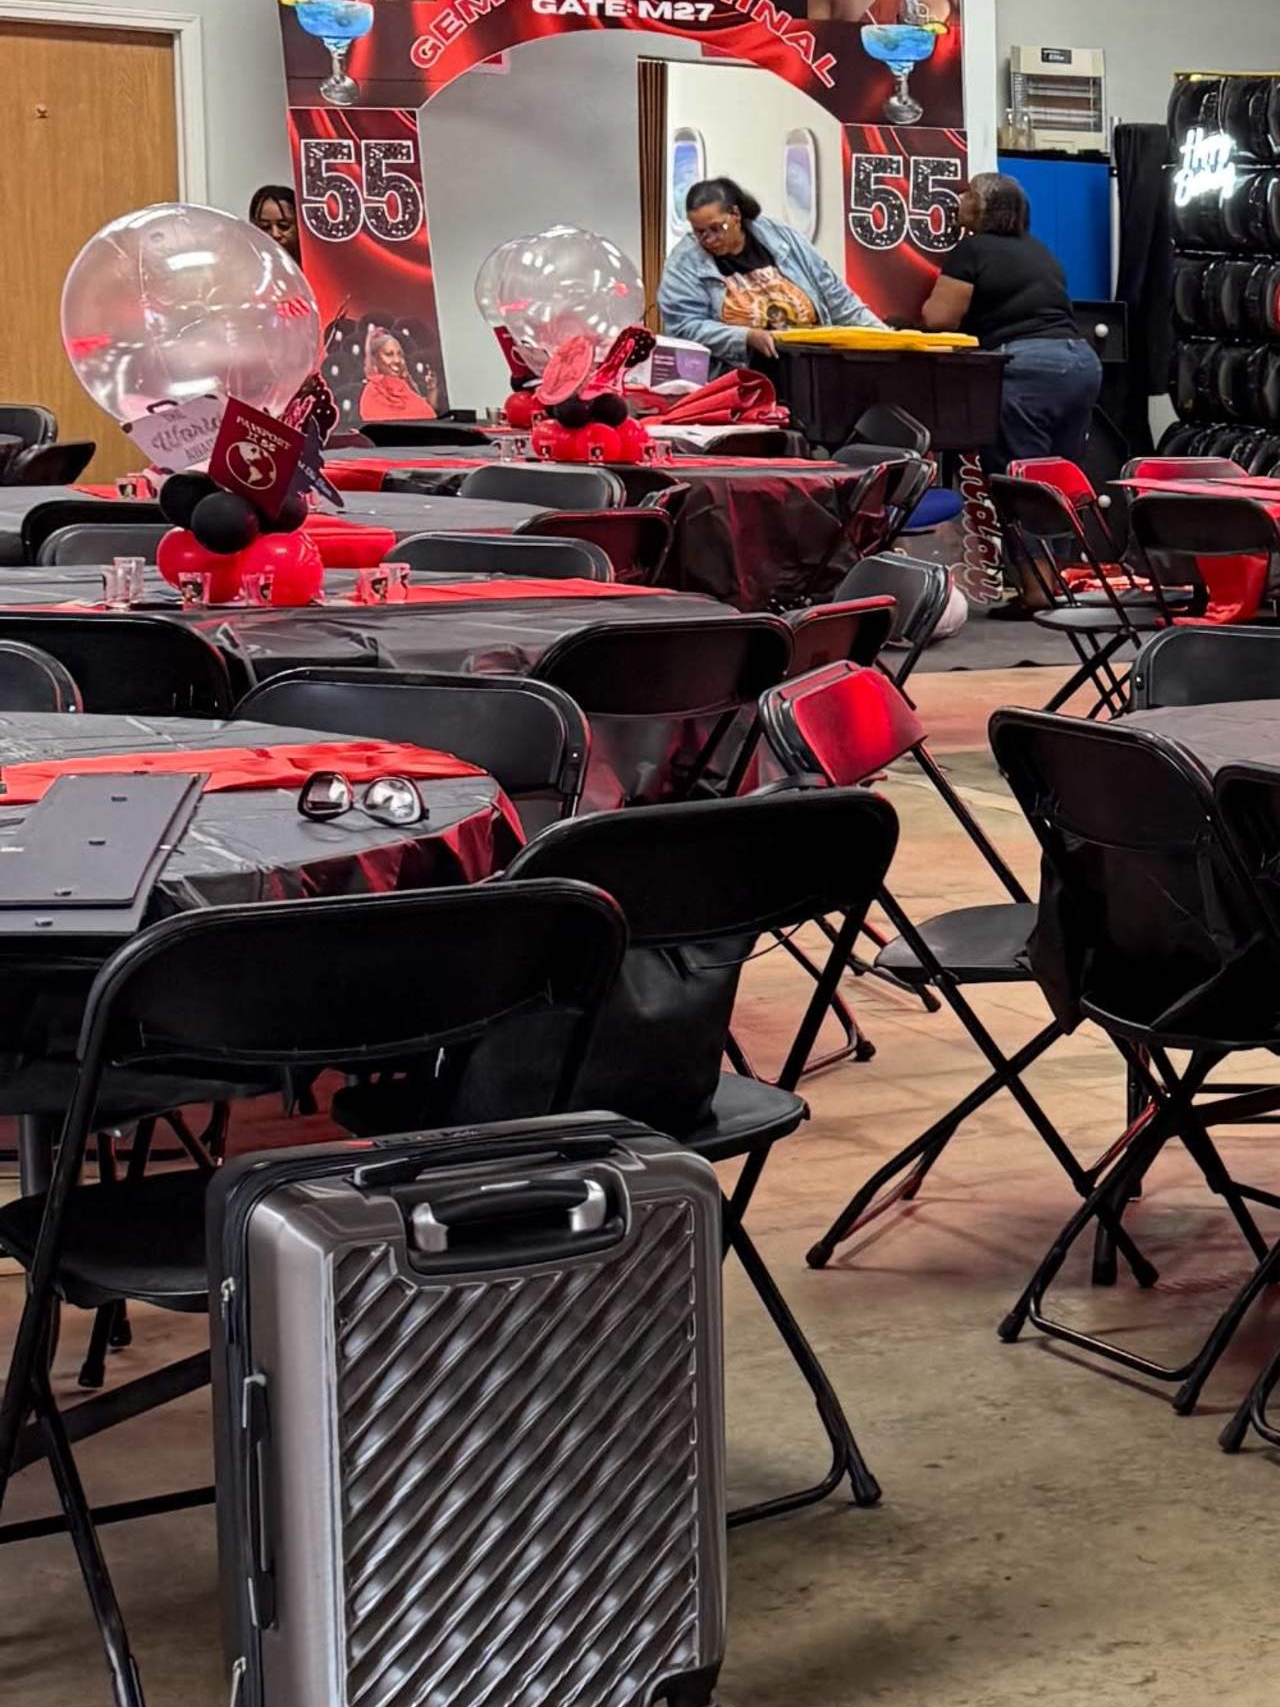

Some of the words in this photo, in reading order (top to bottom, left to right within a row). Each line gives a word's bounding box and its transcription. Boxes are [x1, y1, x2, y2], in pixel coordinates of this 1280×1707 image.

[636, 0, 716, 21] M27
[300, 139, 424, 242] 55
[848, 153, 967, 252] 55
